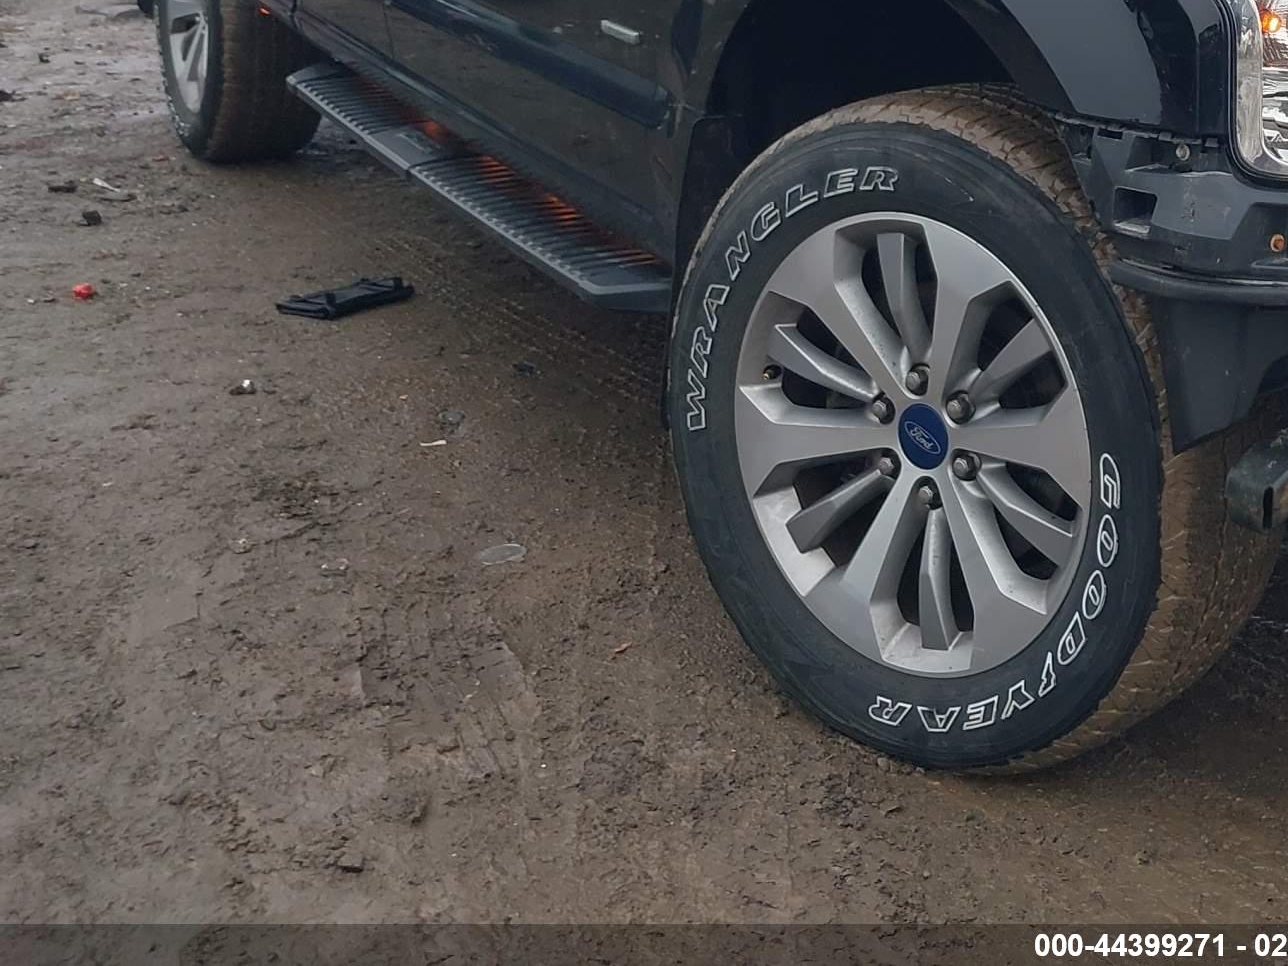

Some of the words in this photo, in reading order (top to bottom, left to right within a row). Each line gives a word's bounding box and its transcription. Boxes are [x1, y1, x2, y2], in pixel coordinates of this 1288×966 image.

[686, 166, 899, 431] WRANGLER
[910, 426, 934, 450] Ford
[868, 453, 1120, 733] GOODYEAR
